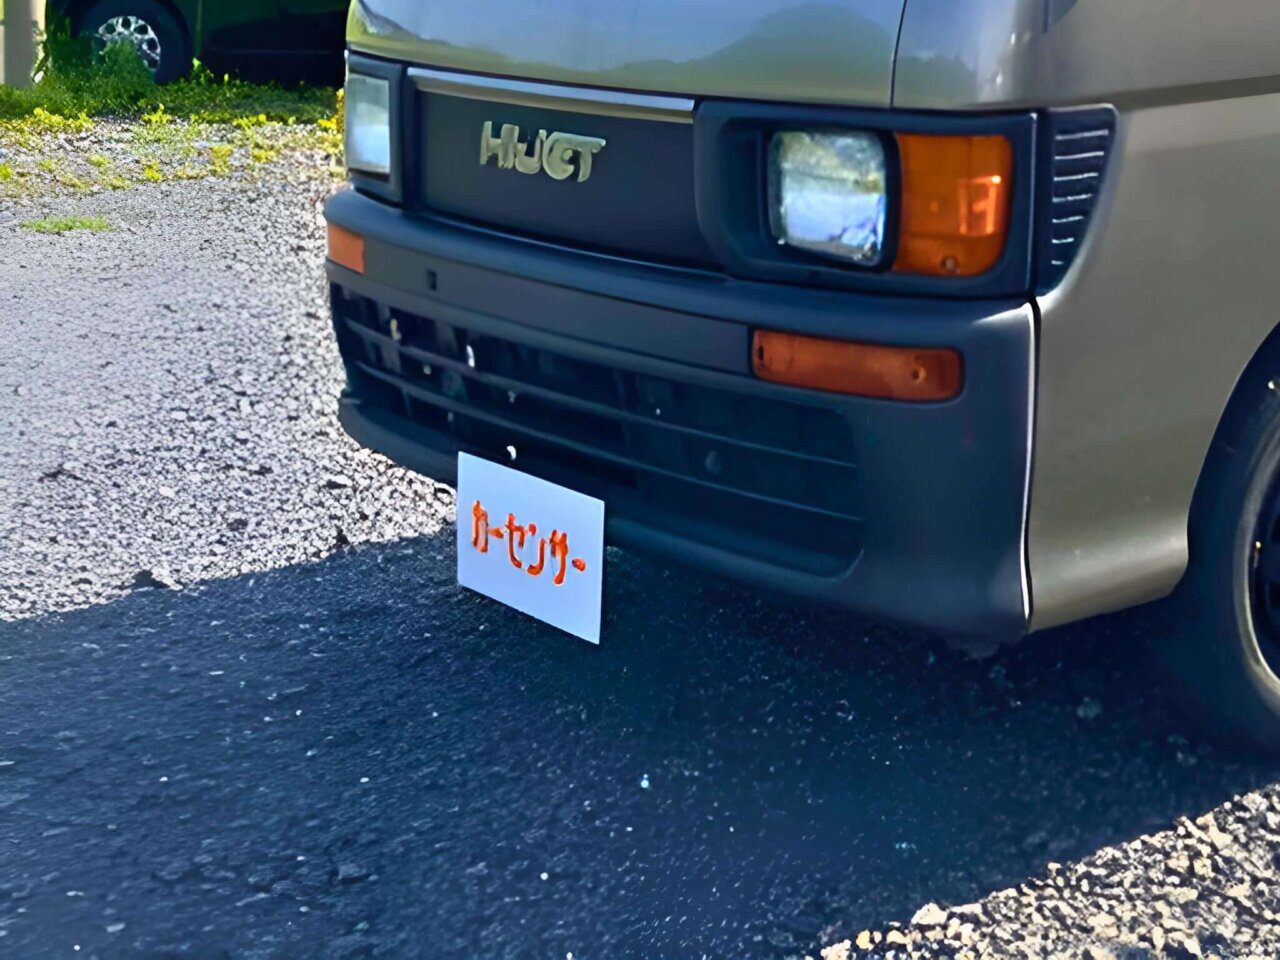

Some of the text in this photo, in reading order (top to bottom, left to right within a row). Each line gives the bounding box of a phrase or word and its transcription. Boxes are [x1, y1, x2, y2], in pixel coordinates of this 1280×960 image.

[472, 500, 586, 585] カーセンサー
